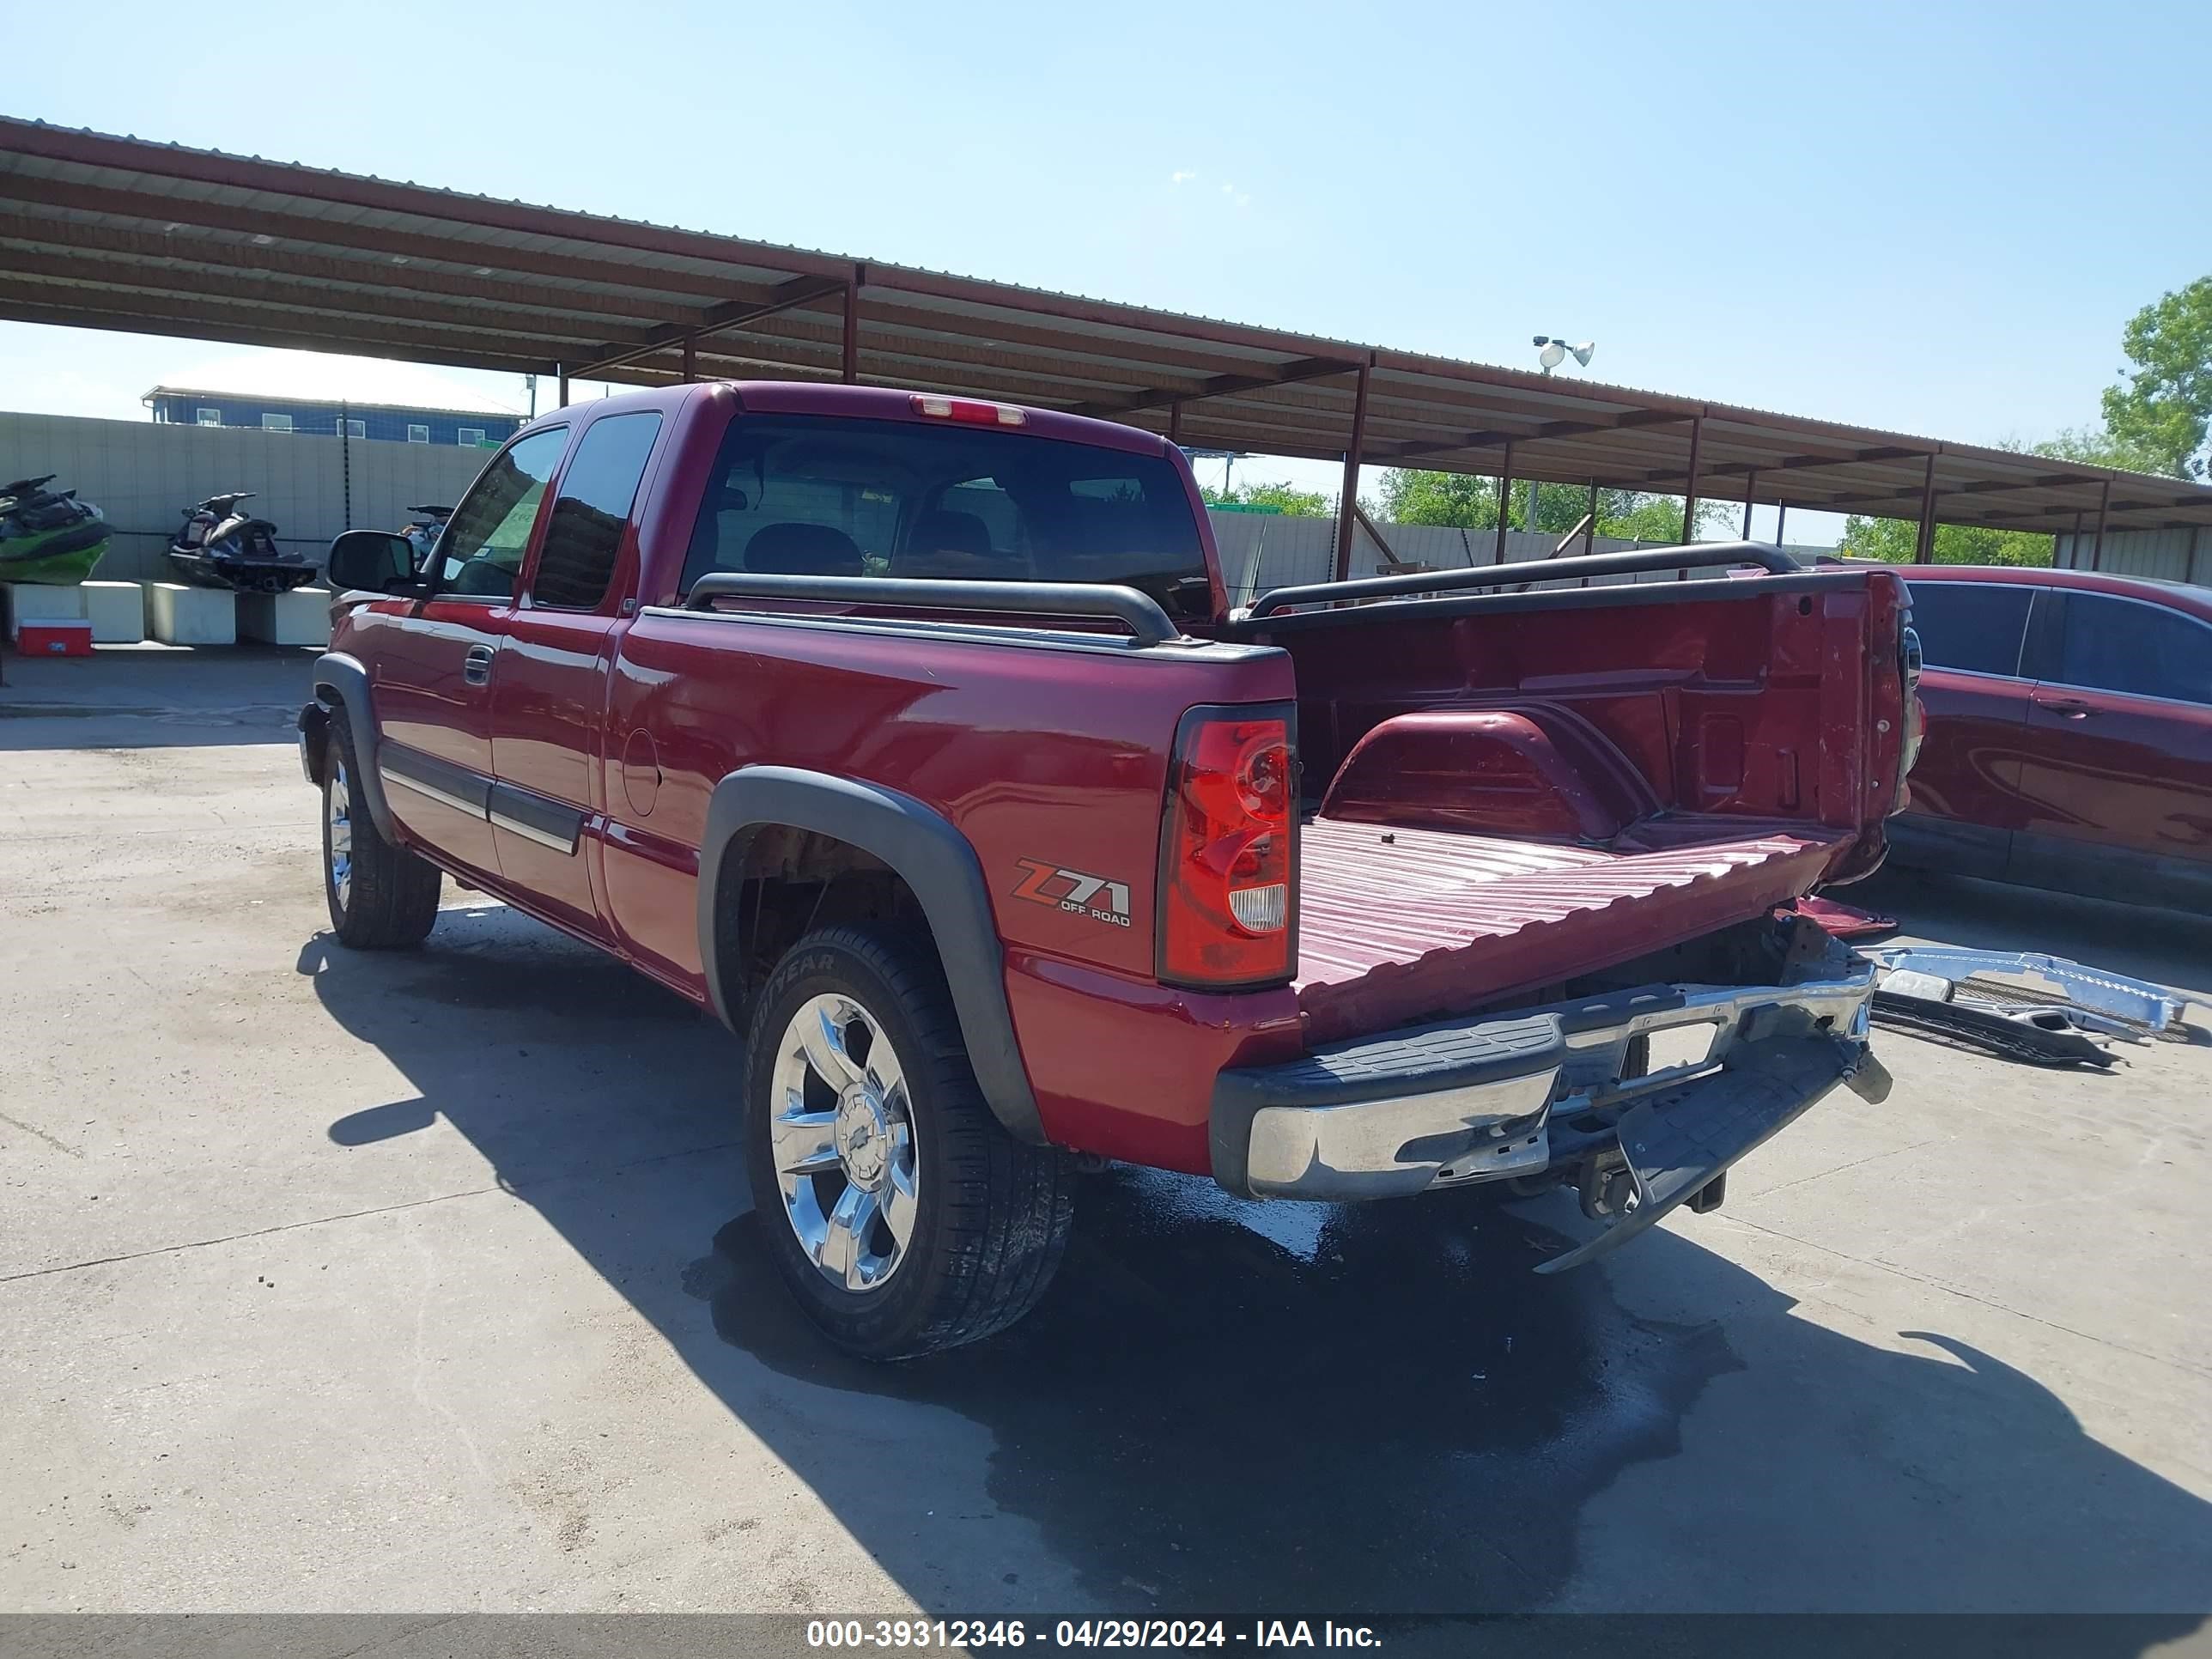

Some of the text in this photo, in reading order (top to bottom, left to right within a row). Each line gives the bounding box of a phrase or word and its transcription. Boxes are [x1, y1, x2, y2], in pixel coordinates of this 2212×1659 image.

[1012, 858, 1130, 915] Z71
[1060, 900, 1131, 928] OFF ROAD
